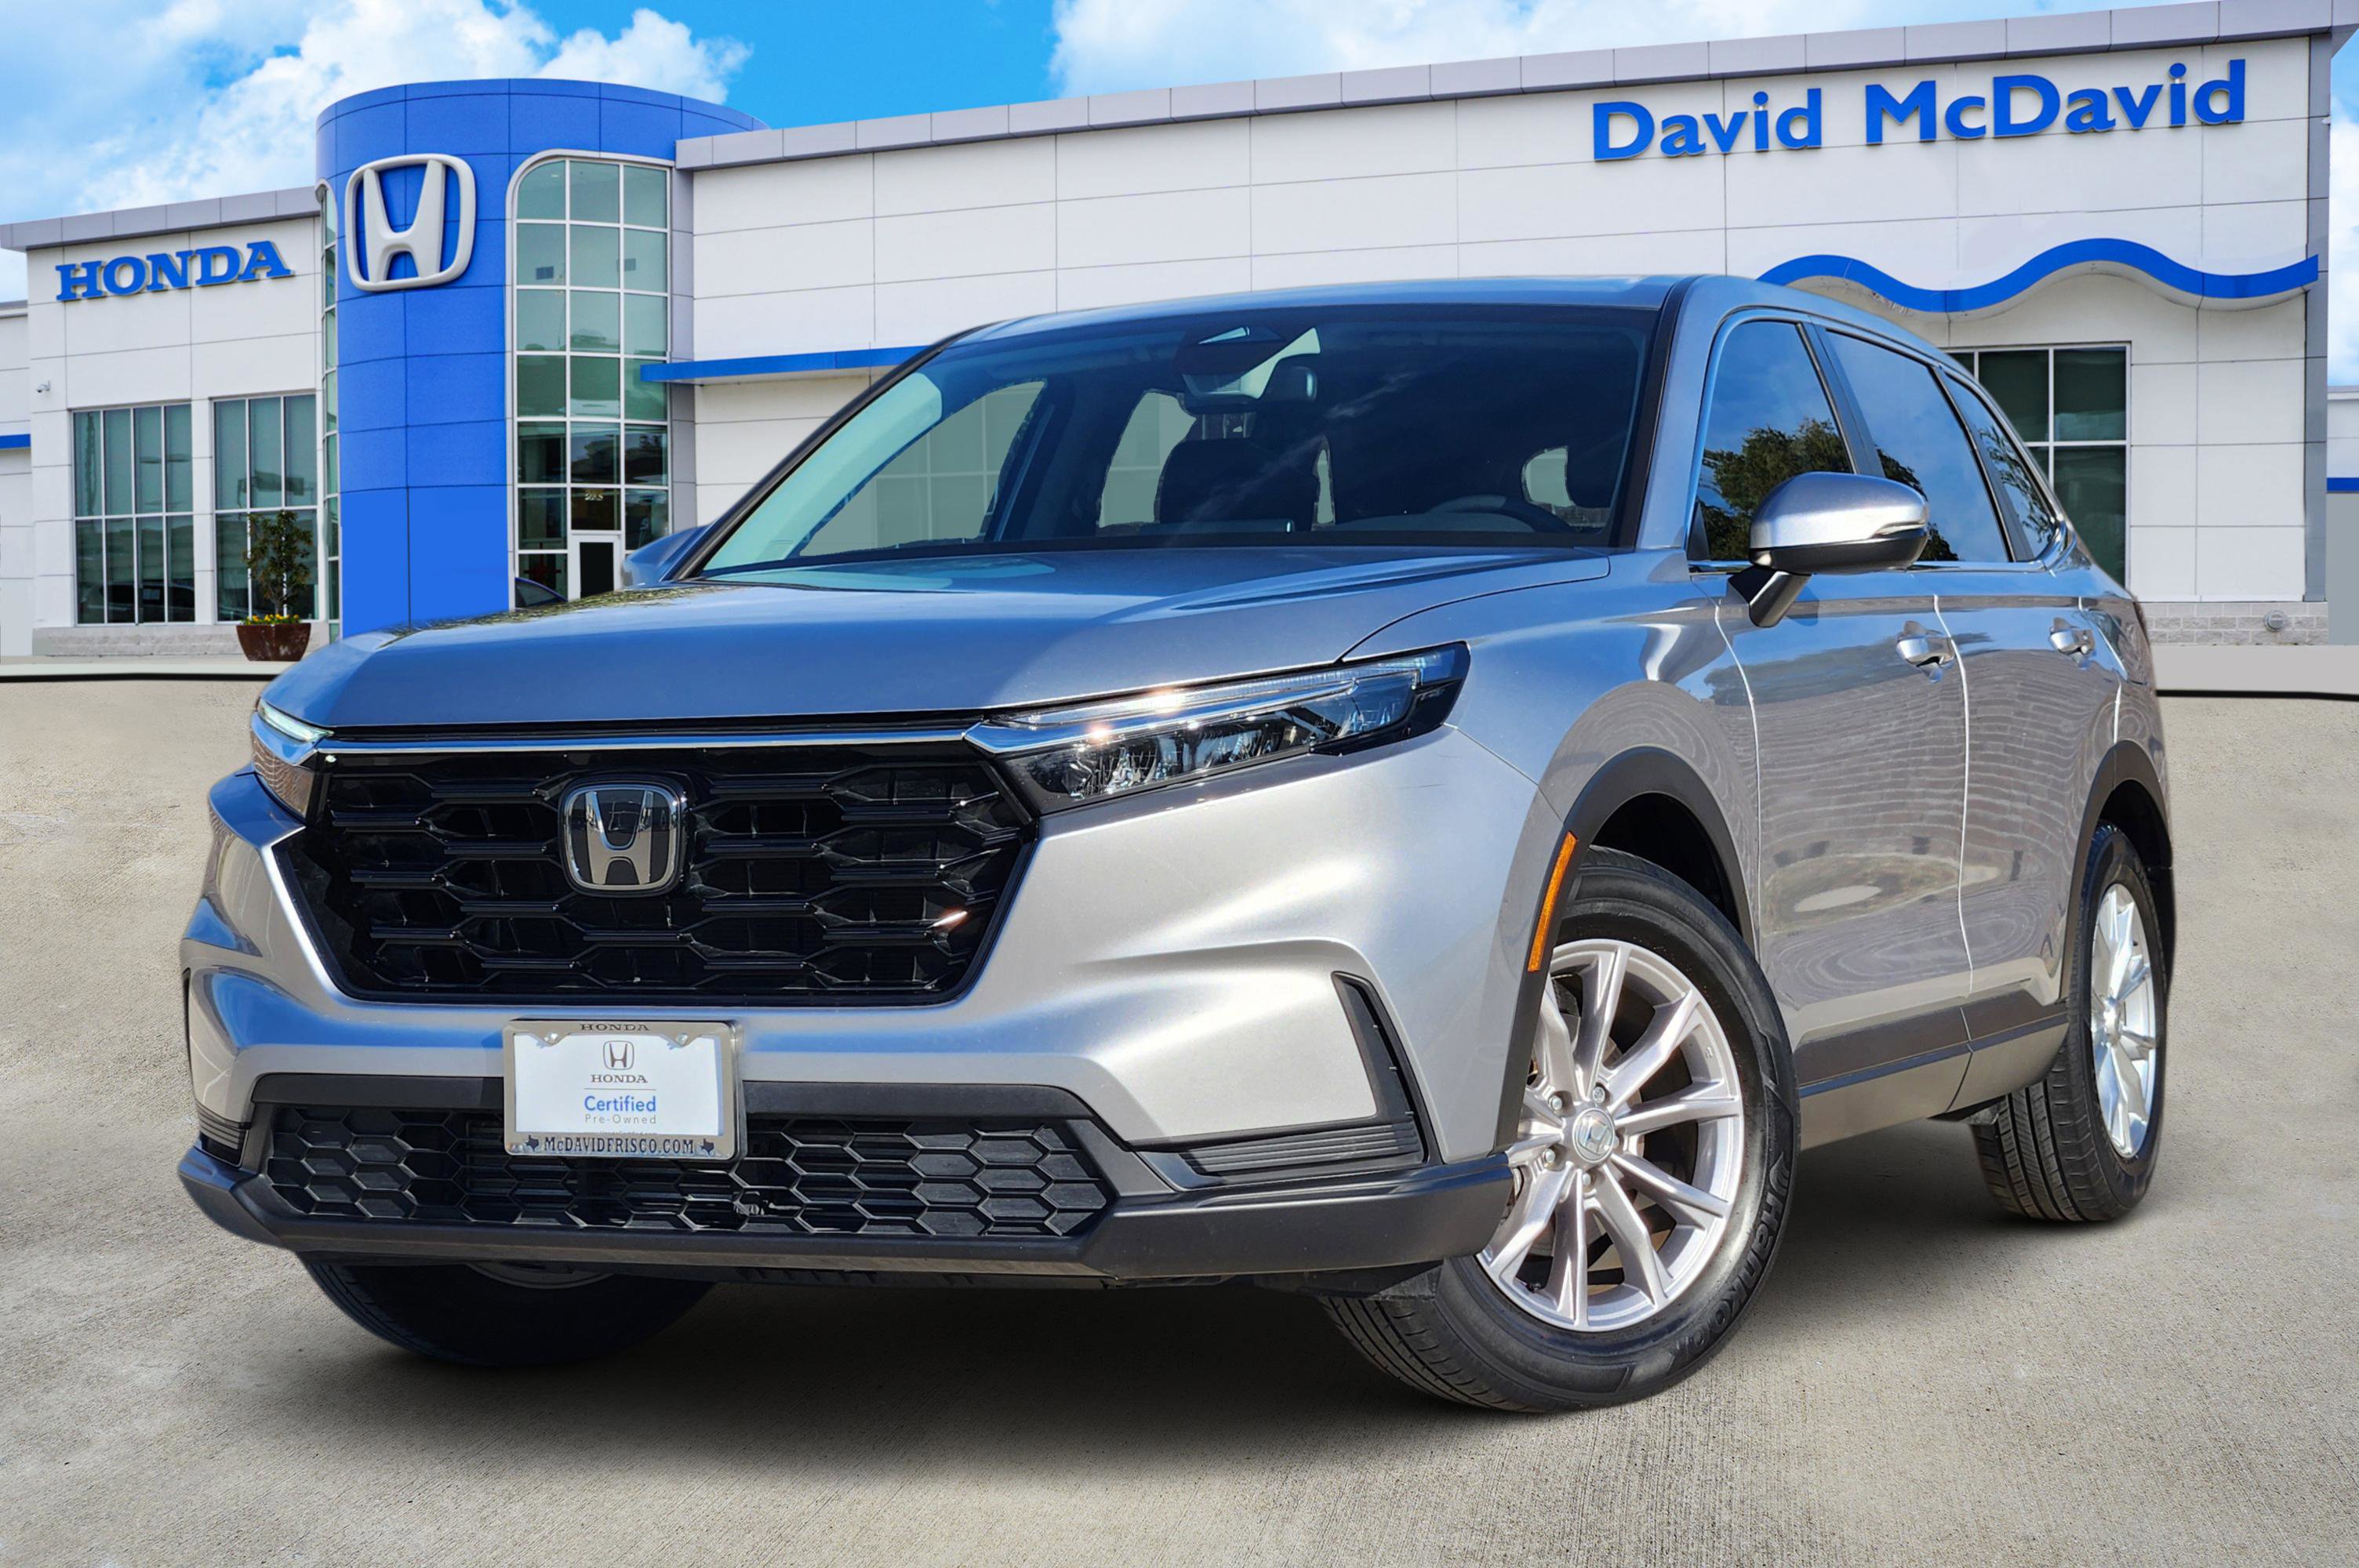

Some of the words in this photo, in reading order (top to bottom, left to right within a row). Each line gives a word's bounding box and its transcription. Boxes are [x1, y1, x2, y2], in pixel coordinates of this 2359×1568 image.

[1593, 88, 1823, 162] David
[1865, 58, 2248, 146] McDavid
[56, 240, 293, 302] HONDA
[580, 1023, 649, 1032] HONDA
[591, 1074, 648, 1083] HONDA
[584, 1095, 656, 1112] Certified
[585, 1113, 656, 1124] Pre-Owned
[544, 1137, 694, 1154] McDAVIDFRISCO.COM
